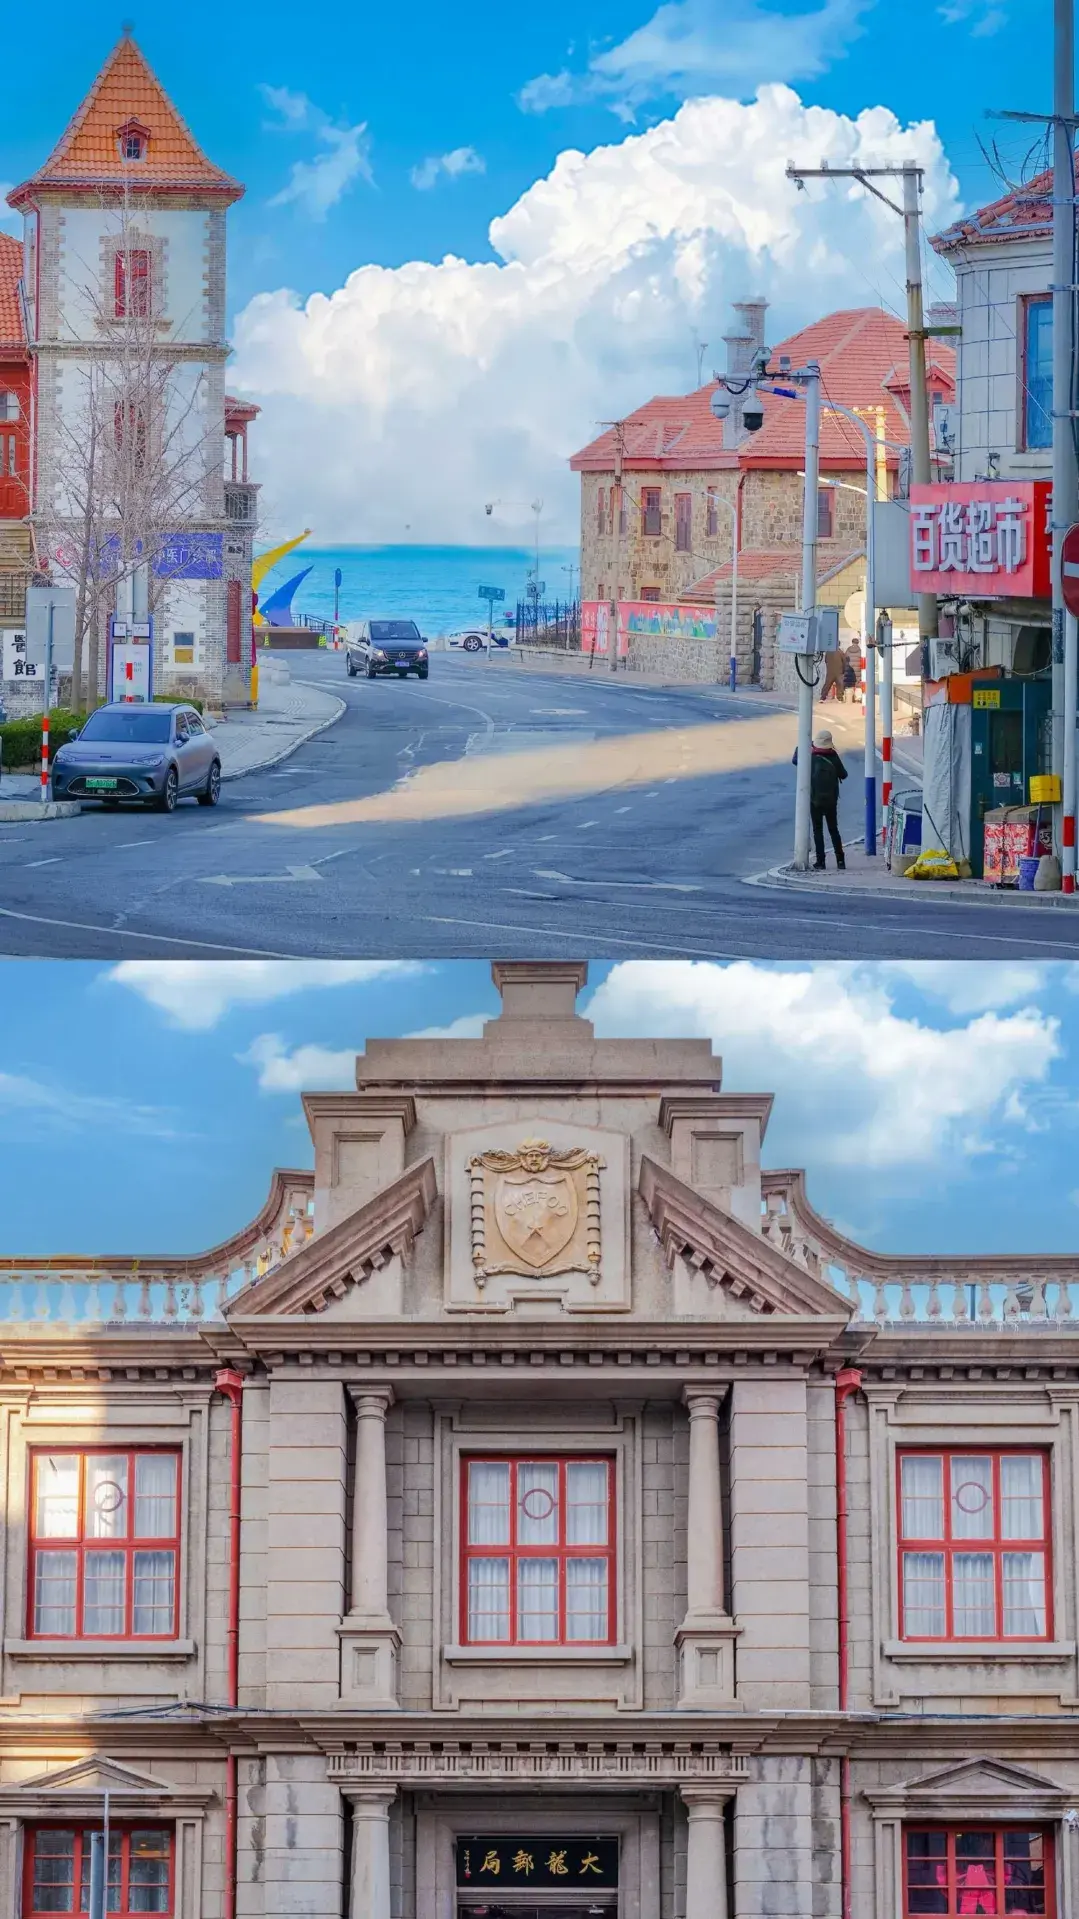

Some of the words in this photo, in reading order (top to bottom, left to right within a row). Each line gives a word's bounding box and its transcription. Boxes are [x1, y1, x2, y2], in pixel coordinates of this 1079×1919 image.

[911, 497, 1028, 575] 百货超市
[504, 1191, 569, 1217] CHEFOO
